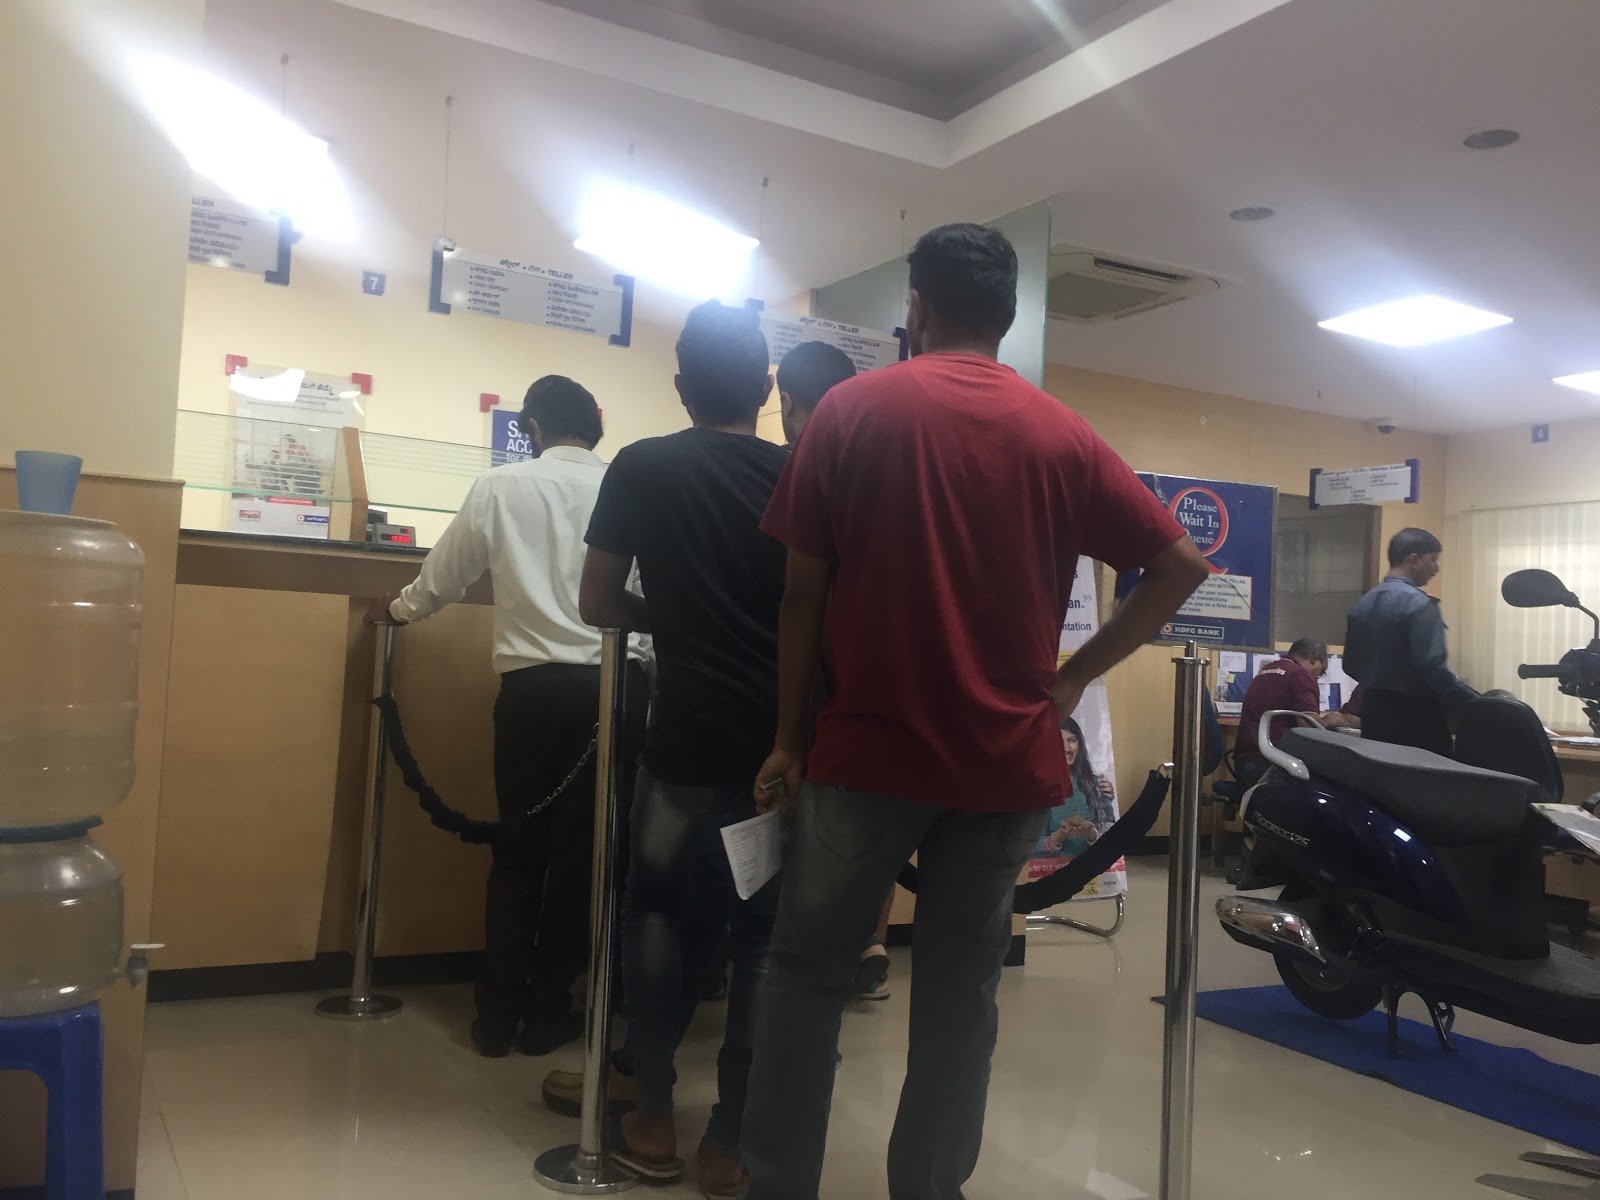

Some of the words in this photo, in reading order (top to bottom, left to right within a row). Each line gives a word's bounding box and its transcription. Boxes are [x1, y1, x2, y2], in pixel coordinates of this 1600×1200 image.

[548, 269, 573, 279] TELLER
[370, 276, 378, 290] 7
[838, 325, 859, 333] TELLER
[1183, 497, 1218, 512] Please
[1179, 511, 1204, 527] Wait
[1208, 515, 1219, 528] In
[1174, 626, 1195, 634] HDFC
[1197, 628, 1220, 636] BANK
